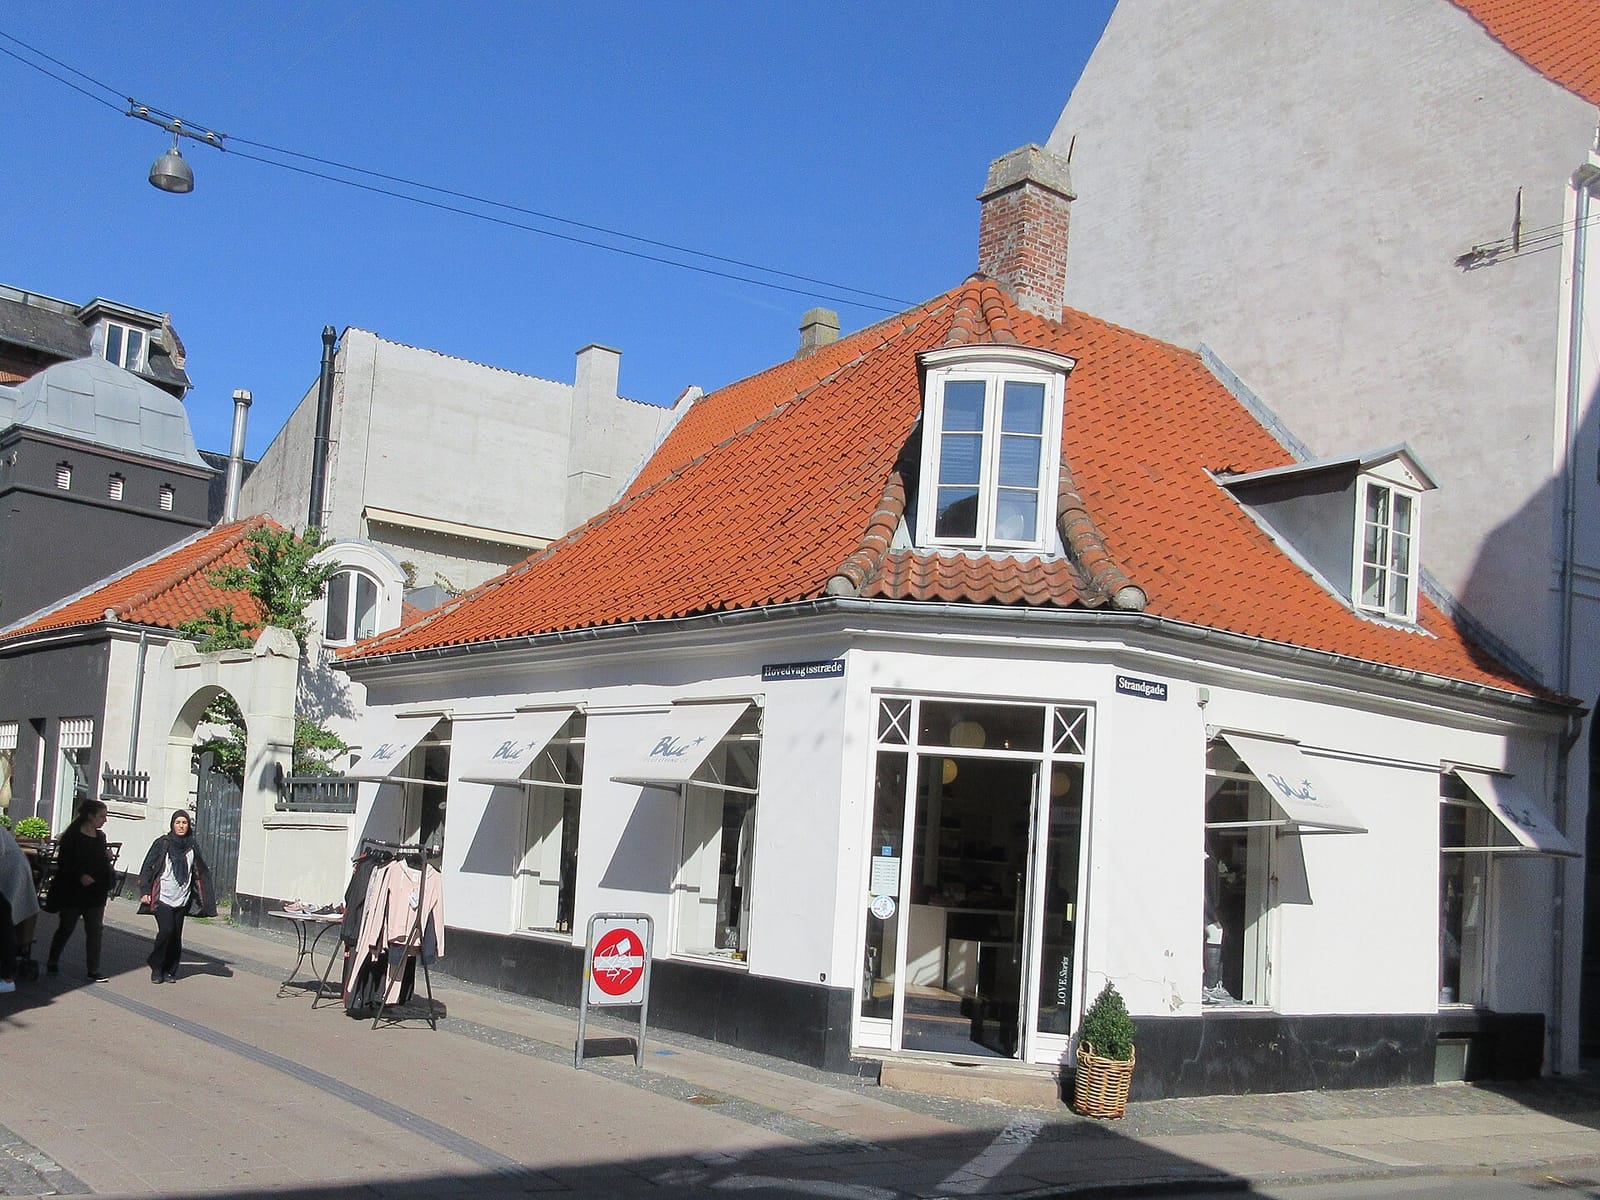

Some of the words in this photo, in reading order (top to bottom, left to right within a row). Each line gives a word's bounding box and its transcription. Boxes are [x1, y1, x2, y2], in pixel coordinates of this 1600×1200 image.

[764, 662, 842, 677] Hovedvagtsstræde
[1118, 677, 1165, 696] Strandgade
[492, 740, 524, 759] Blue
[650, 736, 690, 756] Blue
[1267, 773, 1317, 800] Blue
